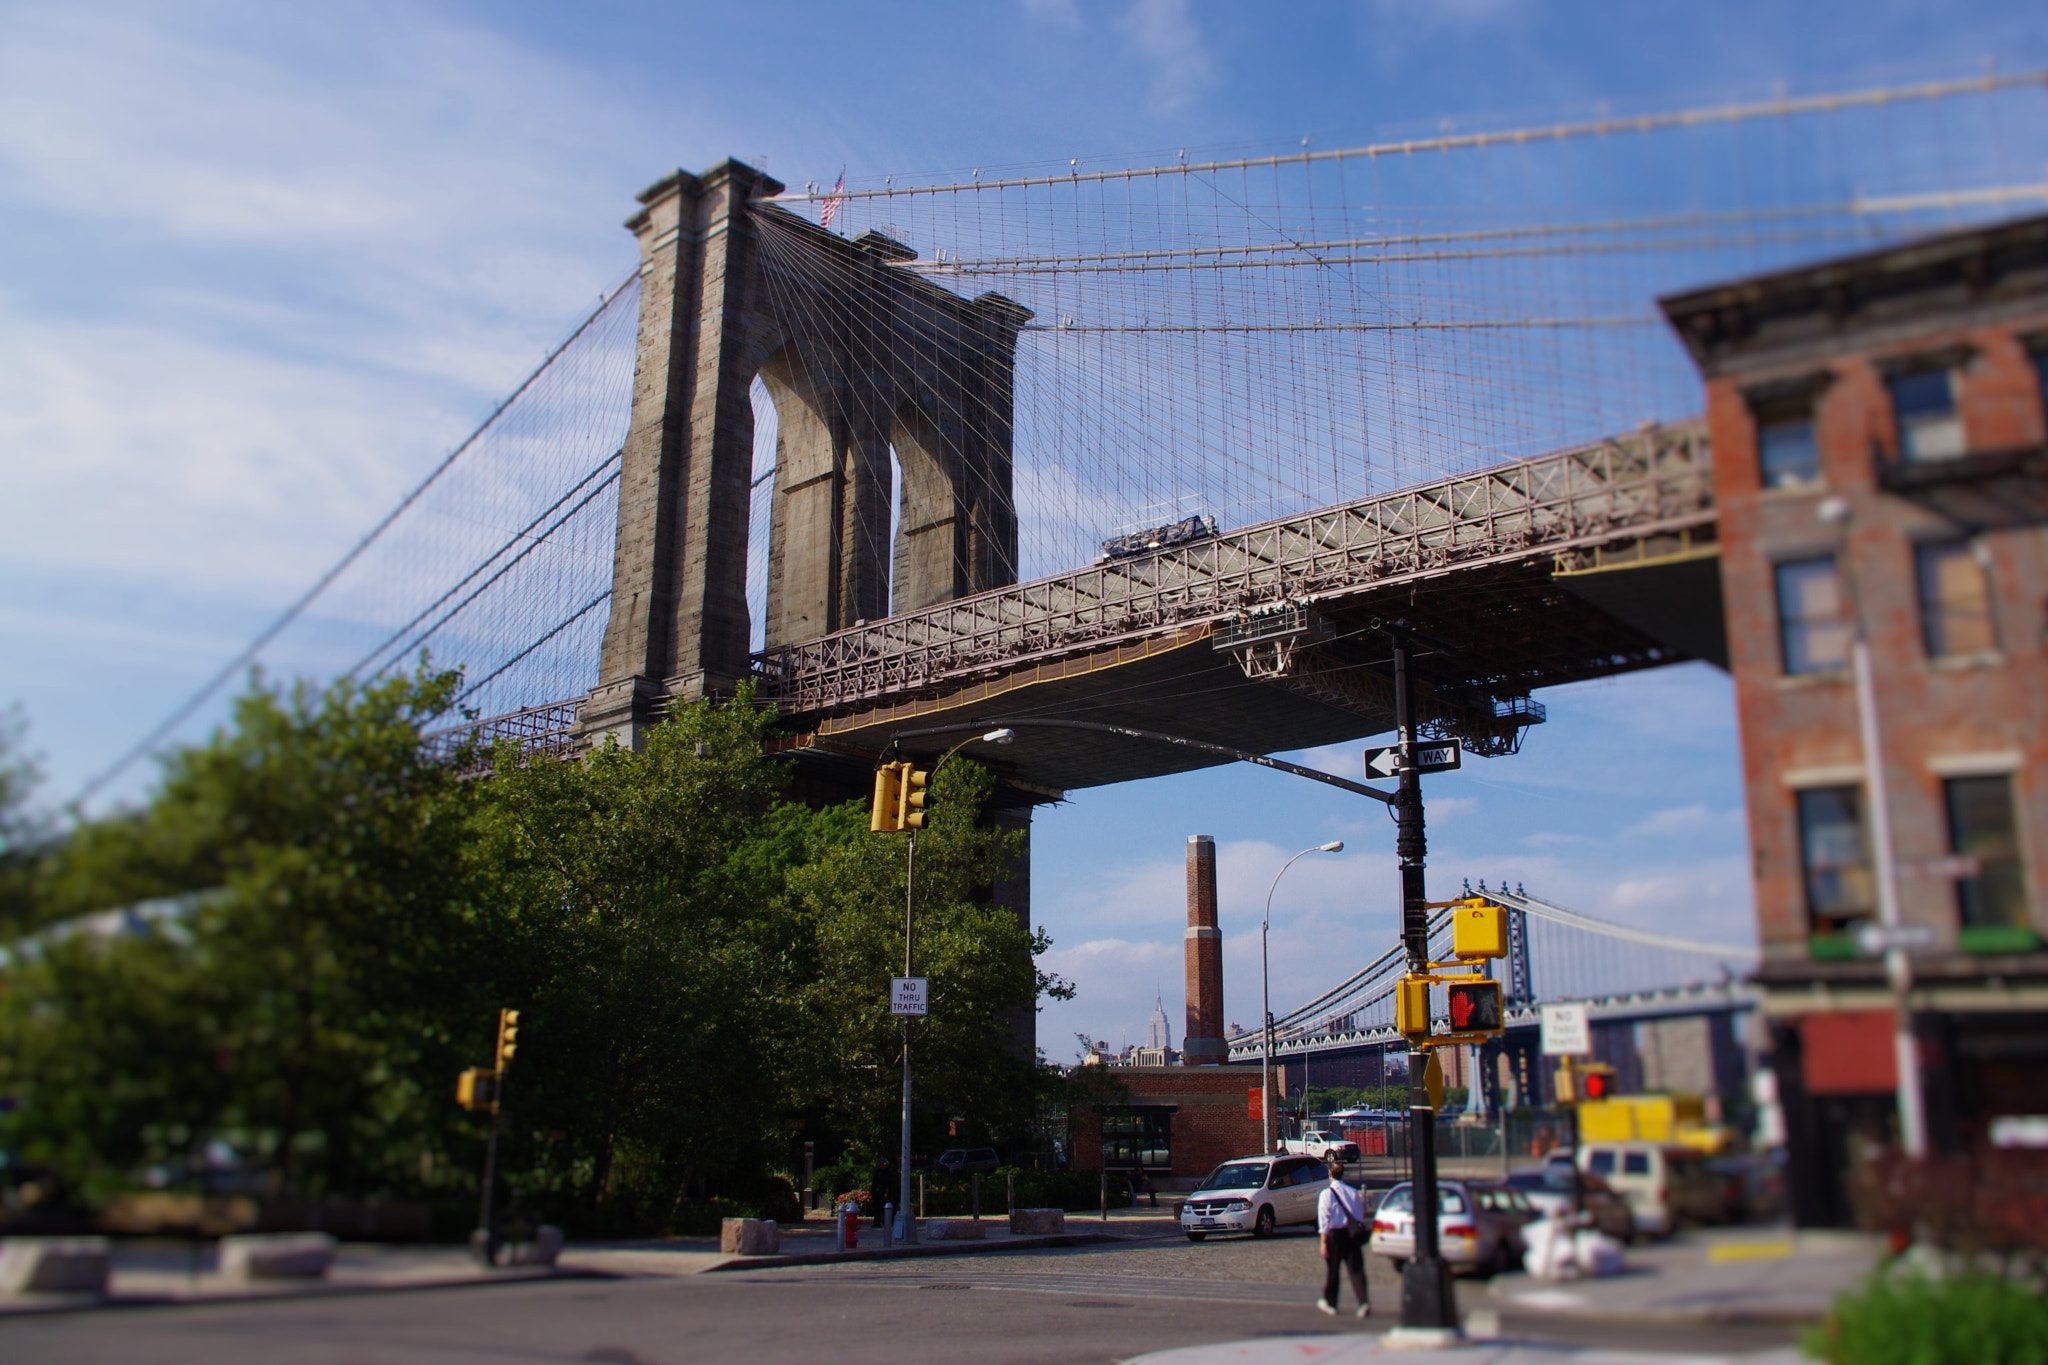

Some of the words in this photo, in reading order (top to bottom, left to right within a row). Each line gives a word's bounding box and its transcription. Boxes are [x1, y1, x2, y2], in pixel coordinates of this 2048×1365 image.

[1423, 749, 1450, 763] WAY
[903, 982, 916, 991] NO
[899, 993, 920, 1001] THRU
[893, 1003, 925, 1011] TRAFFIC
